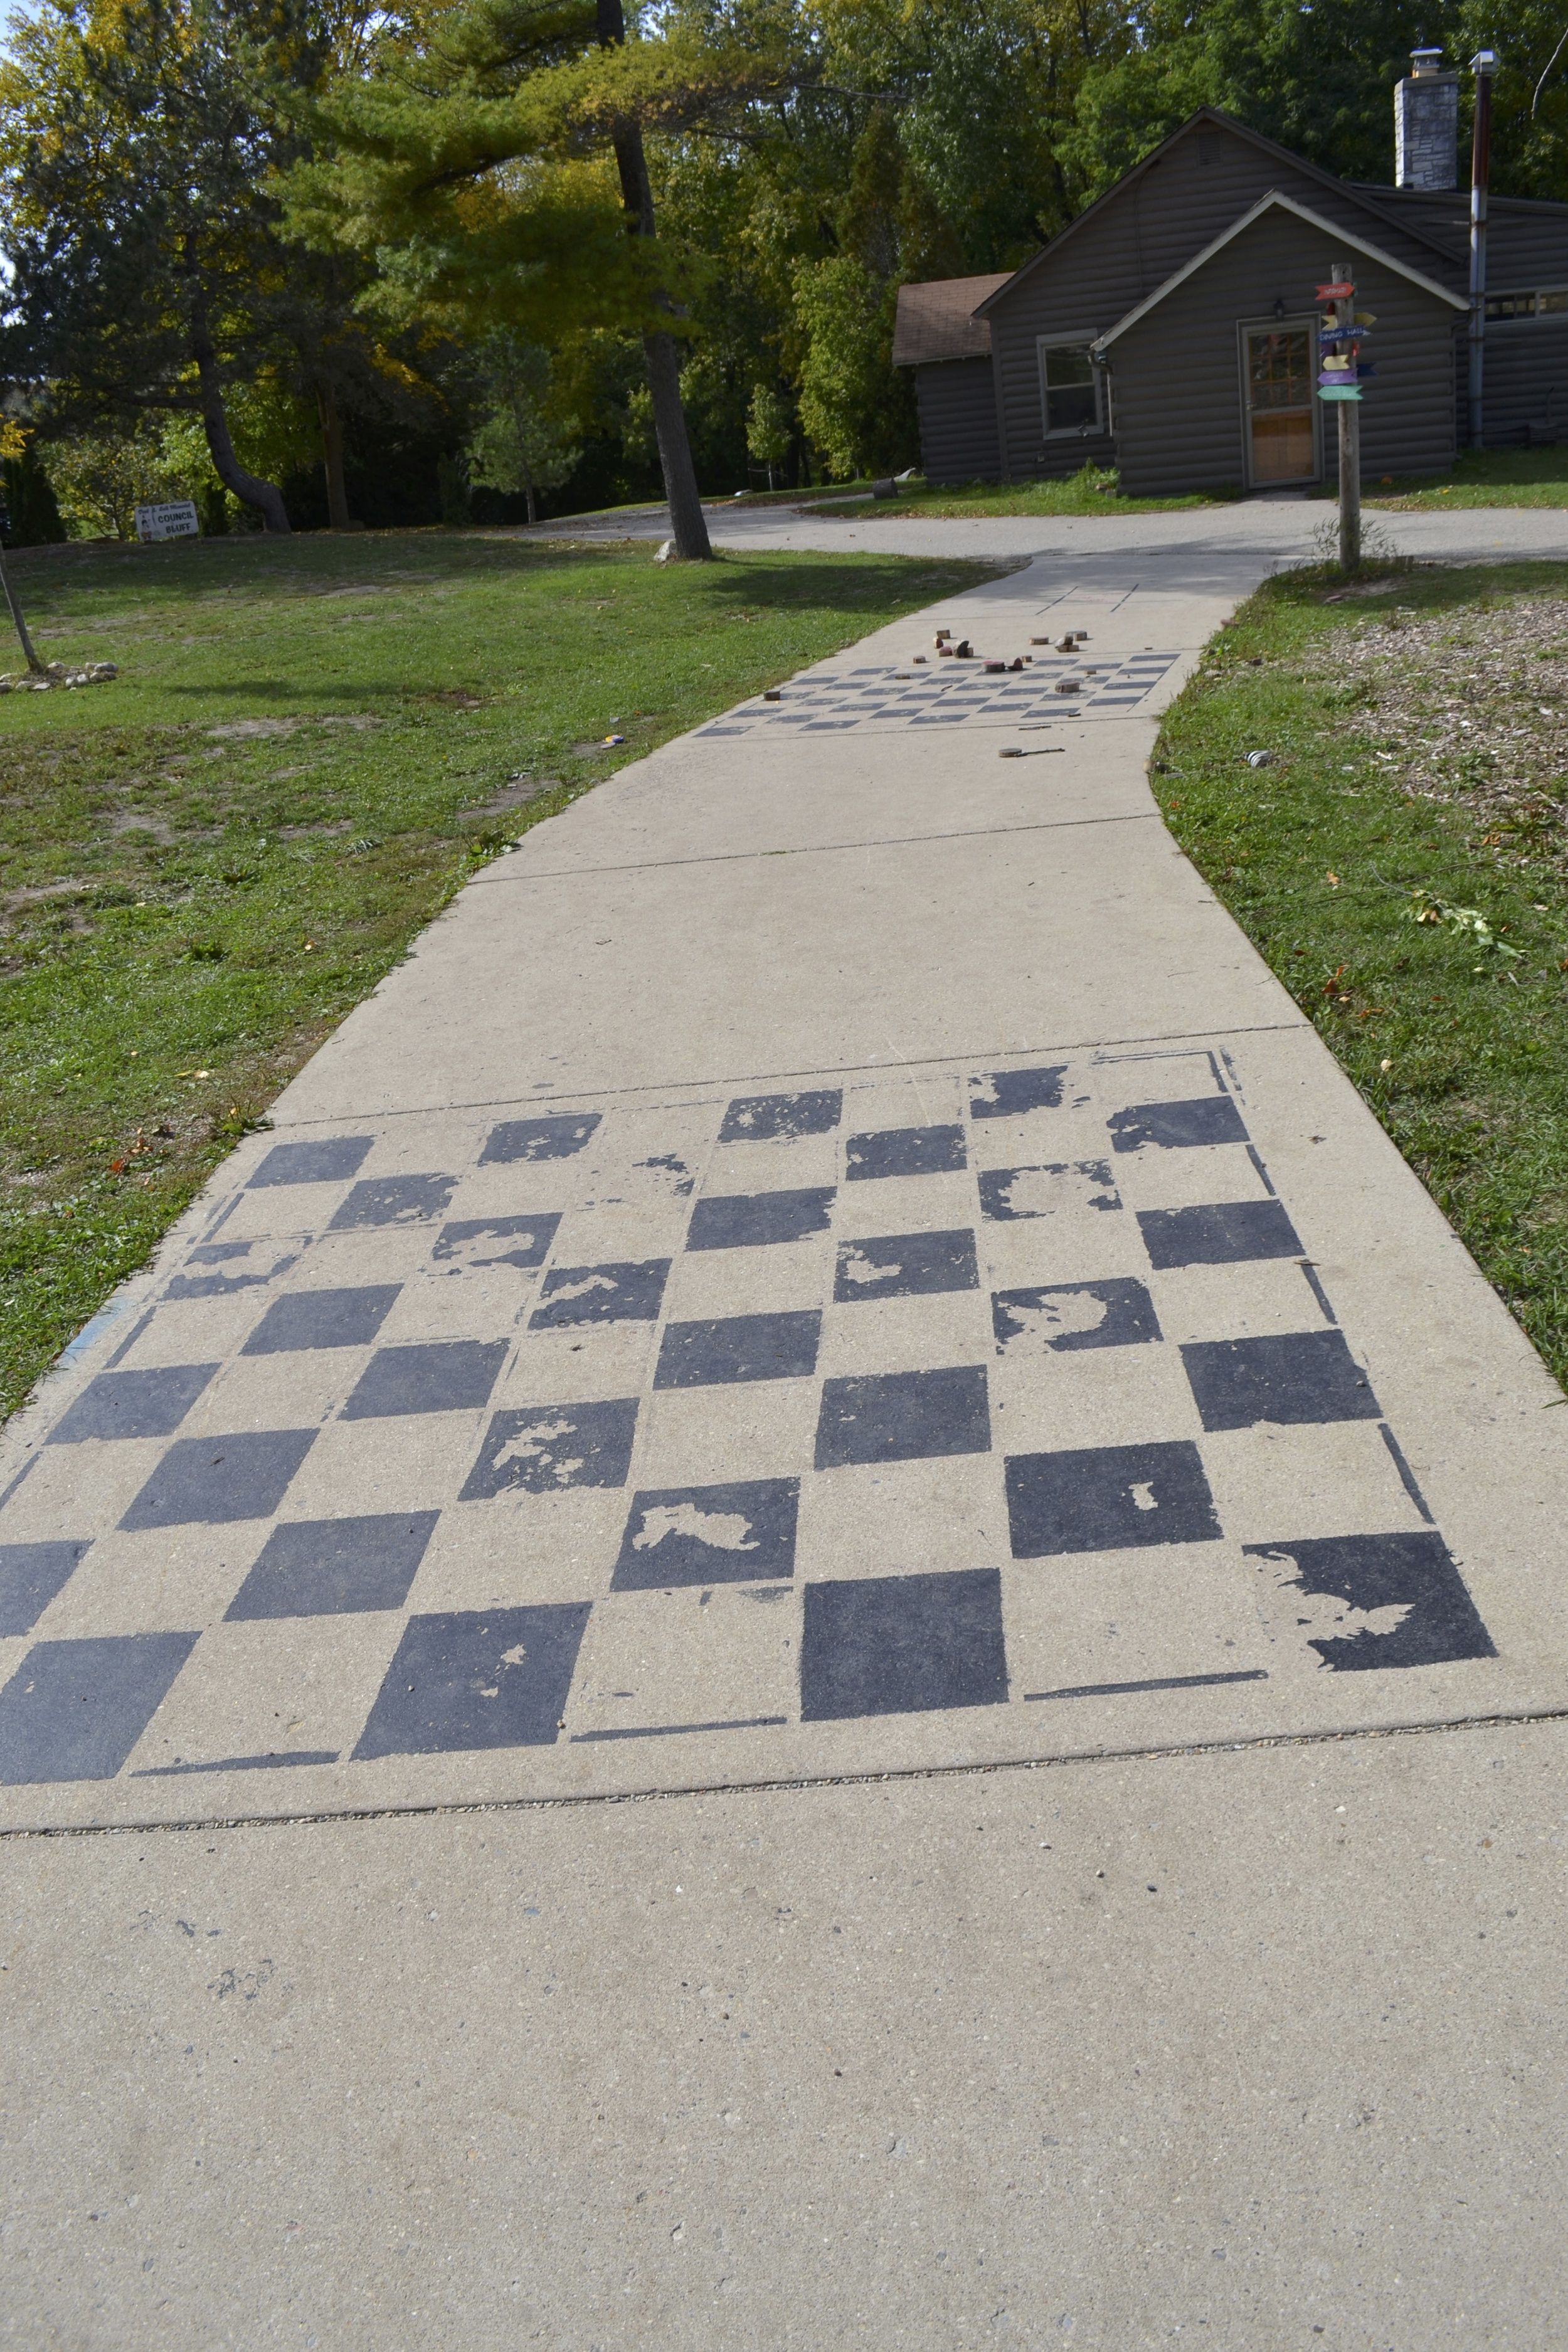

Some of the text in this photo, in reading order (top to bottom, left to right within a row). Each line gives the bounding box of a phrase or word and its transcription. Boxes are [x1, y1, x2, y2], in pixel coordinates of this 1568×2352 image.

[1320, 327, 1364, 341] DINING HALL
[158, 511, 194, 523] COUNCIL
[166, 522, 191, 533] BLUFF
